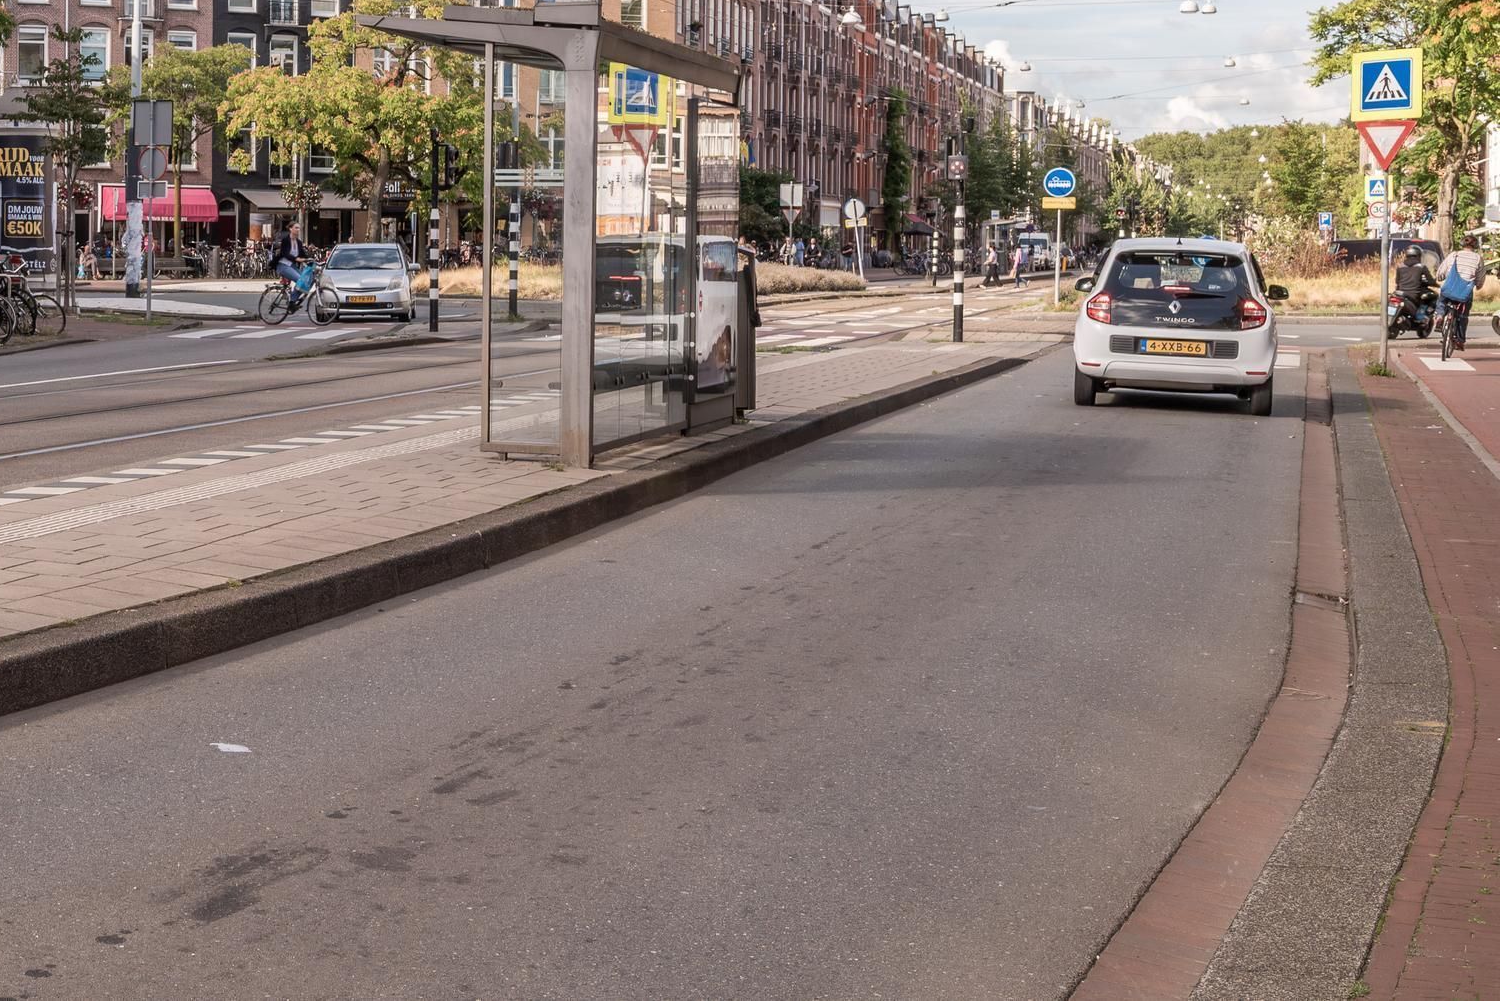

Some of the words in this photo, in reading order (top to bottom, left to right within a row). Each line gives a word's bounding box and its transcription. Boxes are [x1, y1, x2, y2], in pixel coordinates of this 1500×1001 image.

[7, 205, 20, 214] DM
[21, 205, 43, 214] JOUW
[7, 221, 42, 235] €50K
[1150, 341, 1202, 353] 4-XXB-66
